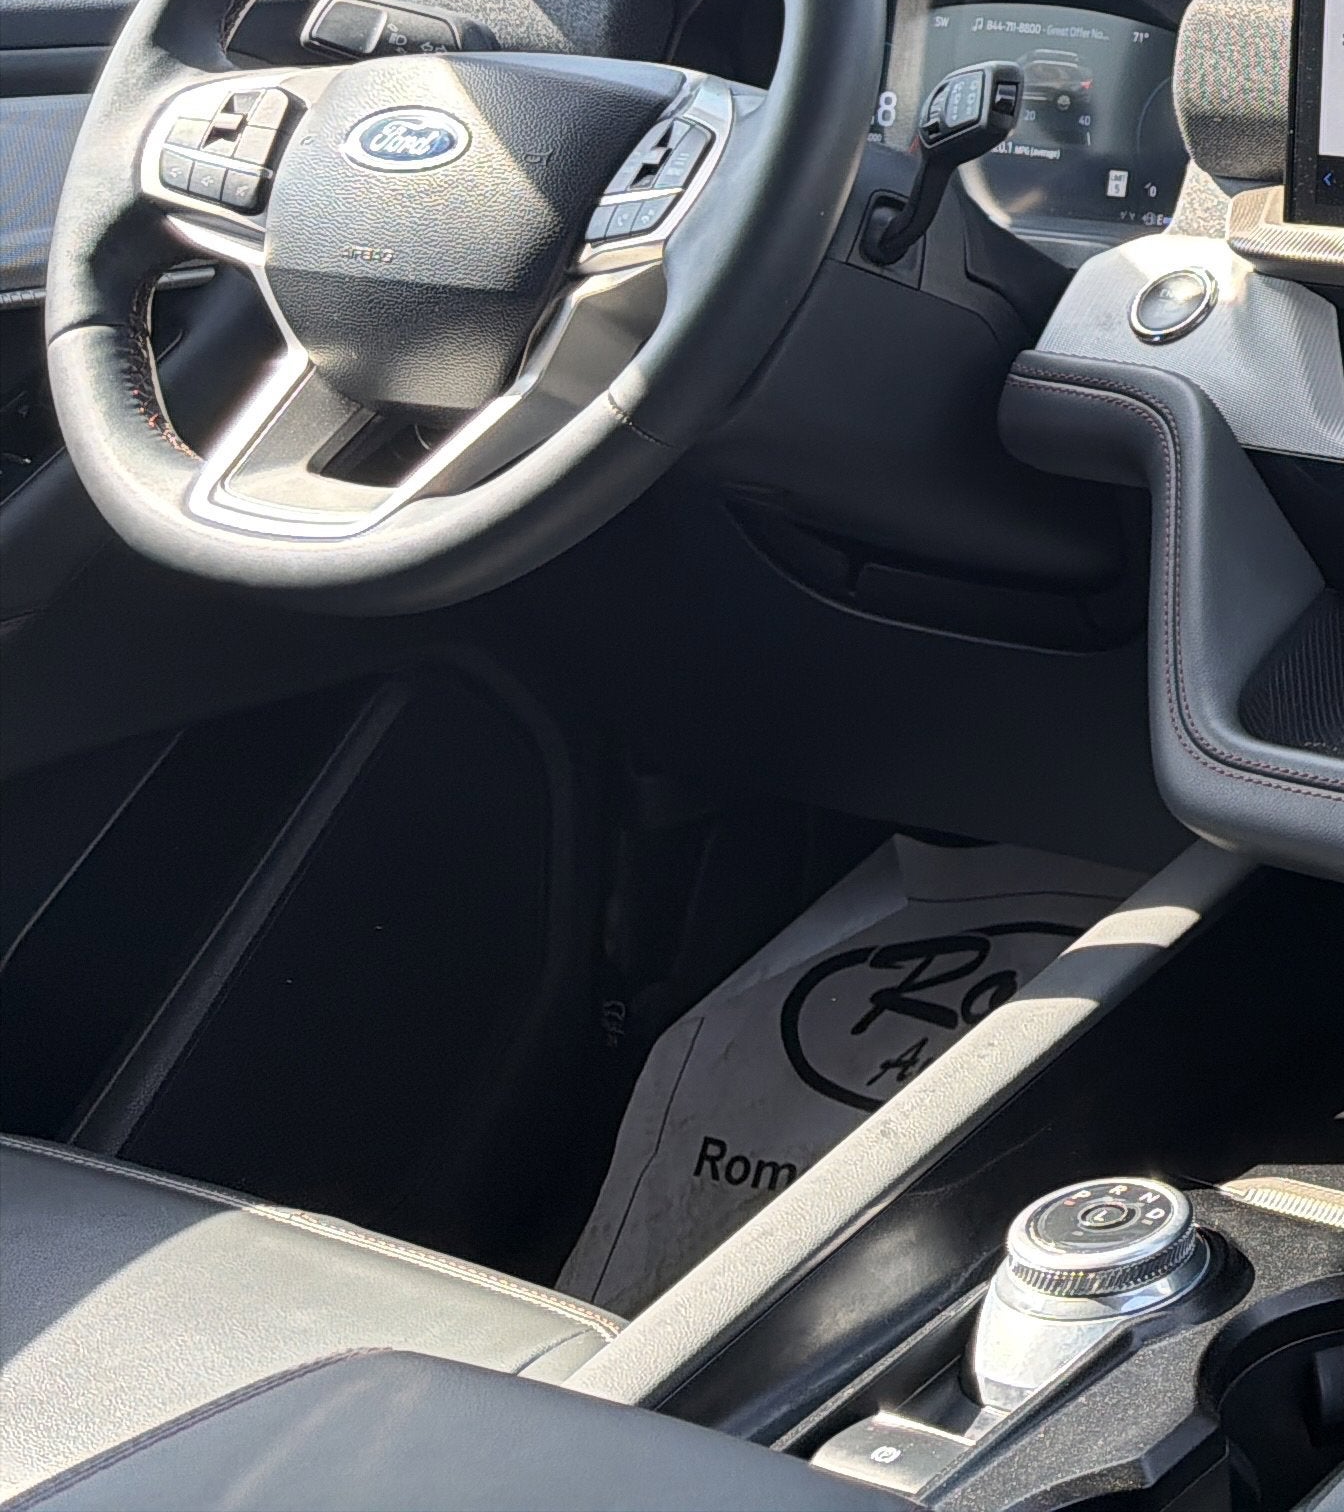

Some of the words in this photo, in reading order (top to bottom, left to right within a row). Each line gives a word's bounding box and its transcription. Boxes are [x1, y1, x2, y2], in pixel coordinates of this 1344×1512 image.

[986, 21, 1041, 35] 844-711-8800
[1078, 115, 1092, 126] 40
[369, 119, 440, 155] Ford
[693, 1136, 797, 1191] Rom
[1072, 1190, 1092, 1200] P
[1109, 1184, 1128, 1196] R
[1139, 1192, 1161, 1203] N
[1094, 1209, 1108, 1221] L
[1145, 1208, 1165, 1219] D
